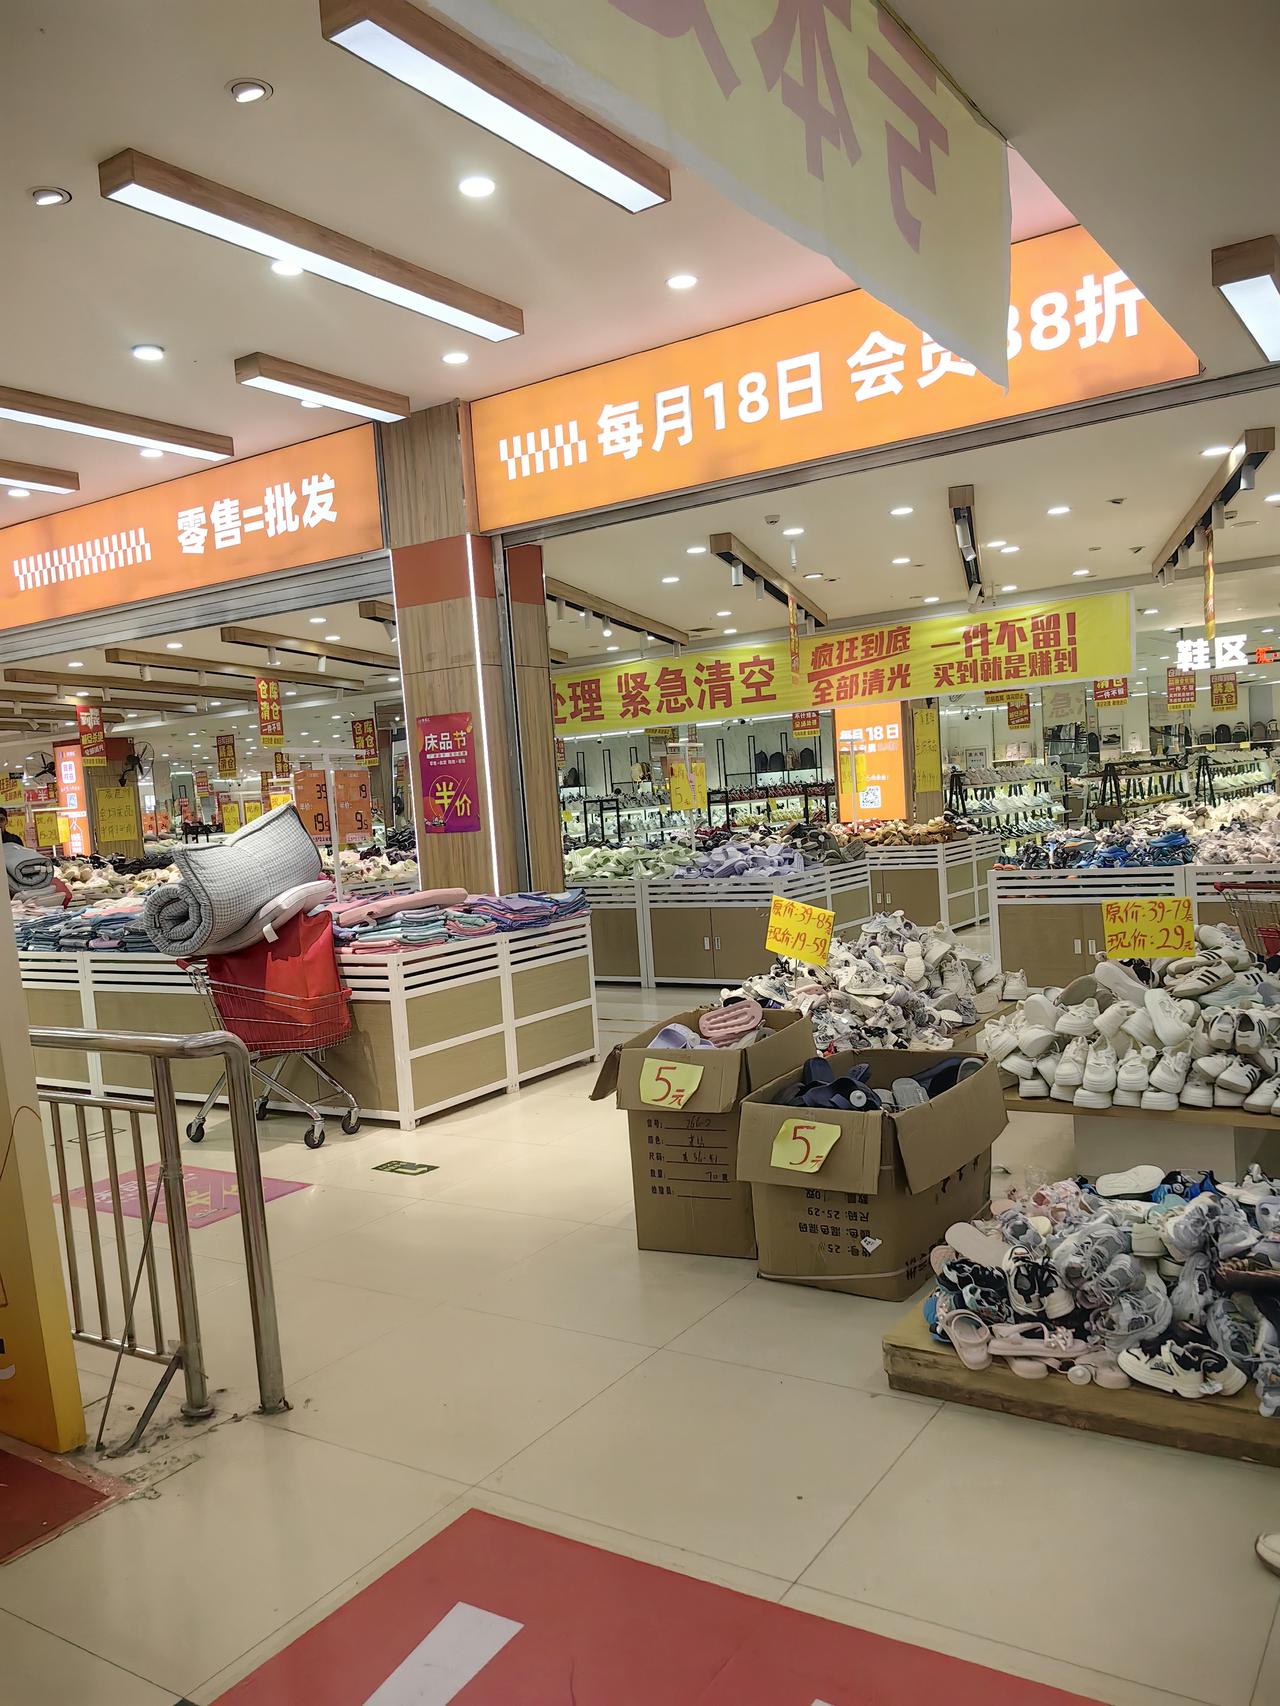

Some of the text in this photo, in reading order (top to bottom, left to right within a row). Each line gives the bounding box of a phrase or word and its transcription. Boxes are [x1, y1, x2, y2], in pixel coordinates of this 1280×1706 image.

[597, 352, 823, 459] 每月18日
[177, 473, 337, 554] 零售=批发
[811, 626, 911, 670] 疯狂到底
[933, 647, 1078, 687] 买到就是赚到
[1176, 634, 1248, 671] 鞋区
[259, 680, 279, 700] 仓库
[617, 655, 777, 719] 紧急清空
[812, 664, 911, 706] 全部清光
[1214, 694, 1235, 704] 清仓
[260, 701, 281, 720] 清仓
[425, 730, 466, 751] 床品节
[435, 781, 471, 817] 半价
[1107, 925, 1193, 953] 现价:29元
[651, 1066, 686, 1107] 5元
